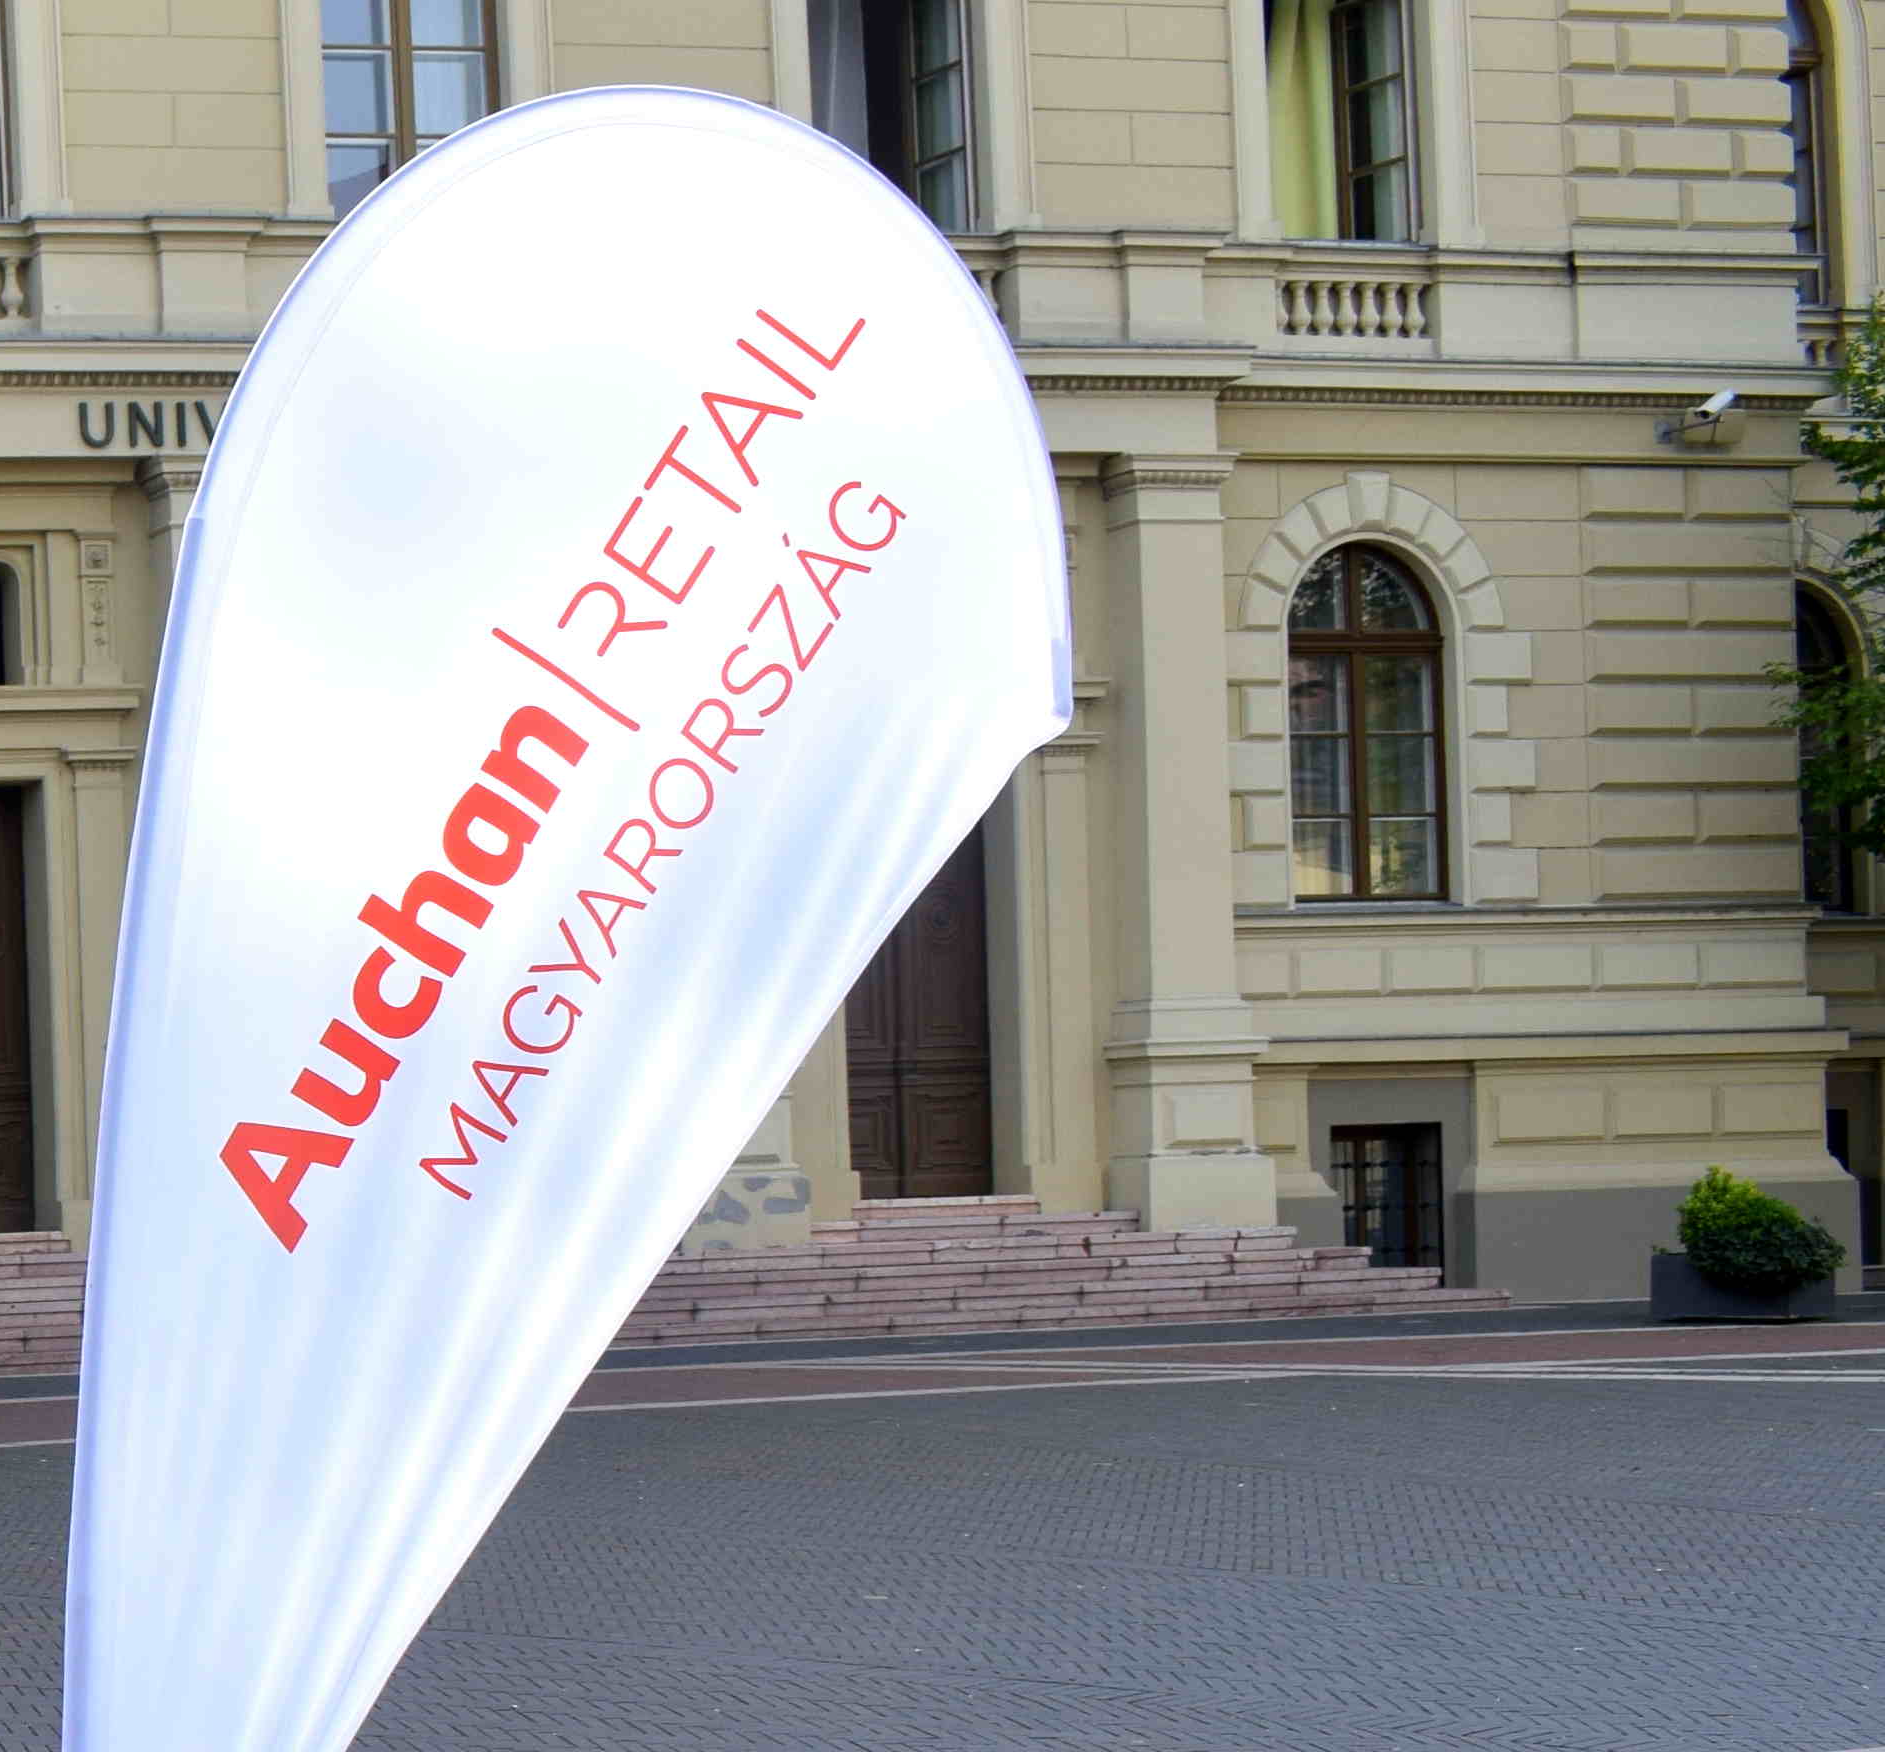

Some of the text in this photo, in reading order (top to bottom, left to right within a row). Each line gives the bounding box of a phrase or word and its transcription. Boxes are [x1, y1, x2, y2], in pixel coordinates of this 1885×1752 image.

[220, 309, 866, 1253] Auchan RETAIL
[419, 480, 906, 1200] MAGYARORSZÁG
